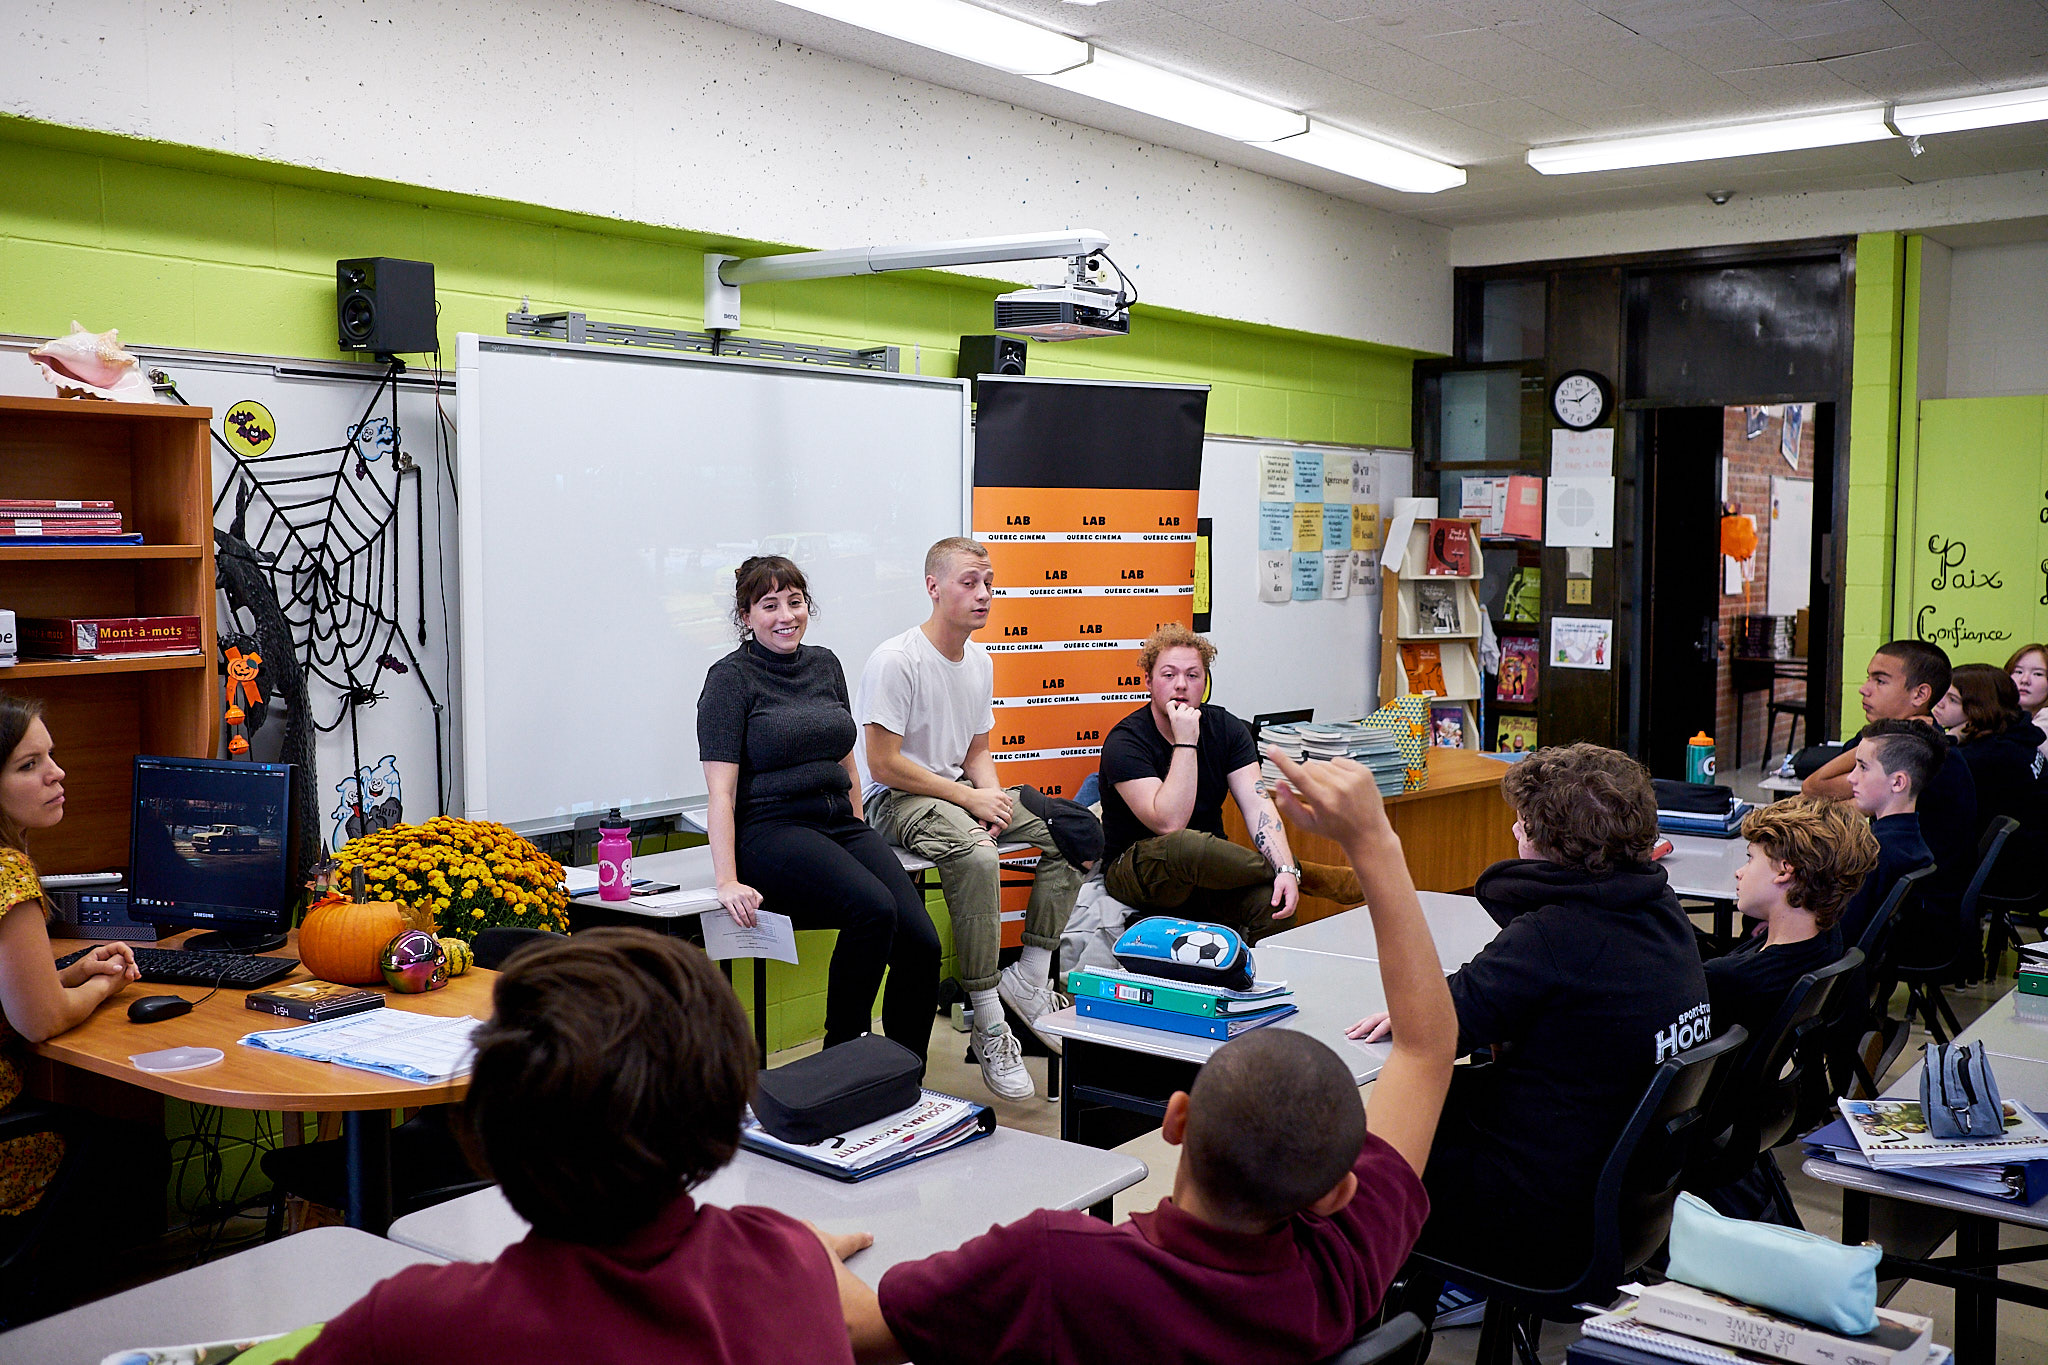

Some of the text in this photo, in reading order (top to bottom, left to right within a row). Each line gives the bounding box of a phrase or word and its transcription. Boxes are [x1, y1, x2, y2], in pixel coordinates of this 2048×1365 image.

[1006, 515, 1031, 526] LAB
[1082, 516, 1106, 526] LAB
[1158, 516, 1180, 526] LAB
[1928, 534, 2003, 591] Paix
[1045, 570, 1068, 580] LAB
[1121, 569, 1144, 579] LAB
[1004, 626, 1028, 636] LAB
[1079, 624, 1103, 634] LAB
[1916, 605, 2012, 648] Confiance
[100, 627, 182, 639] Mont-à-mots
[1042, 679, 1065, 689] LAB
[1117, 676, 1141, 686] LAB
[1002, 735, 1026, 745] LAB
[1076, 730, 1100, 741] LAB
[1039, 785, 1062, 796] LAB
[381, 807, 397, 818] RIP
[273, 1005, 289, 1016] 1:54
[1725, 1316, 1796, 1346] DE KATWE
[1729, 1330, 1789, 1356] LA DAME
